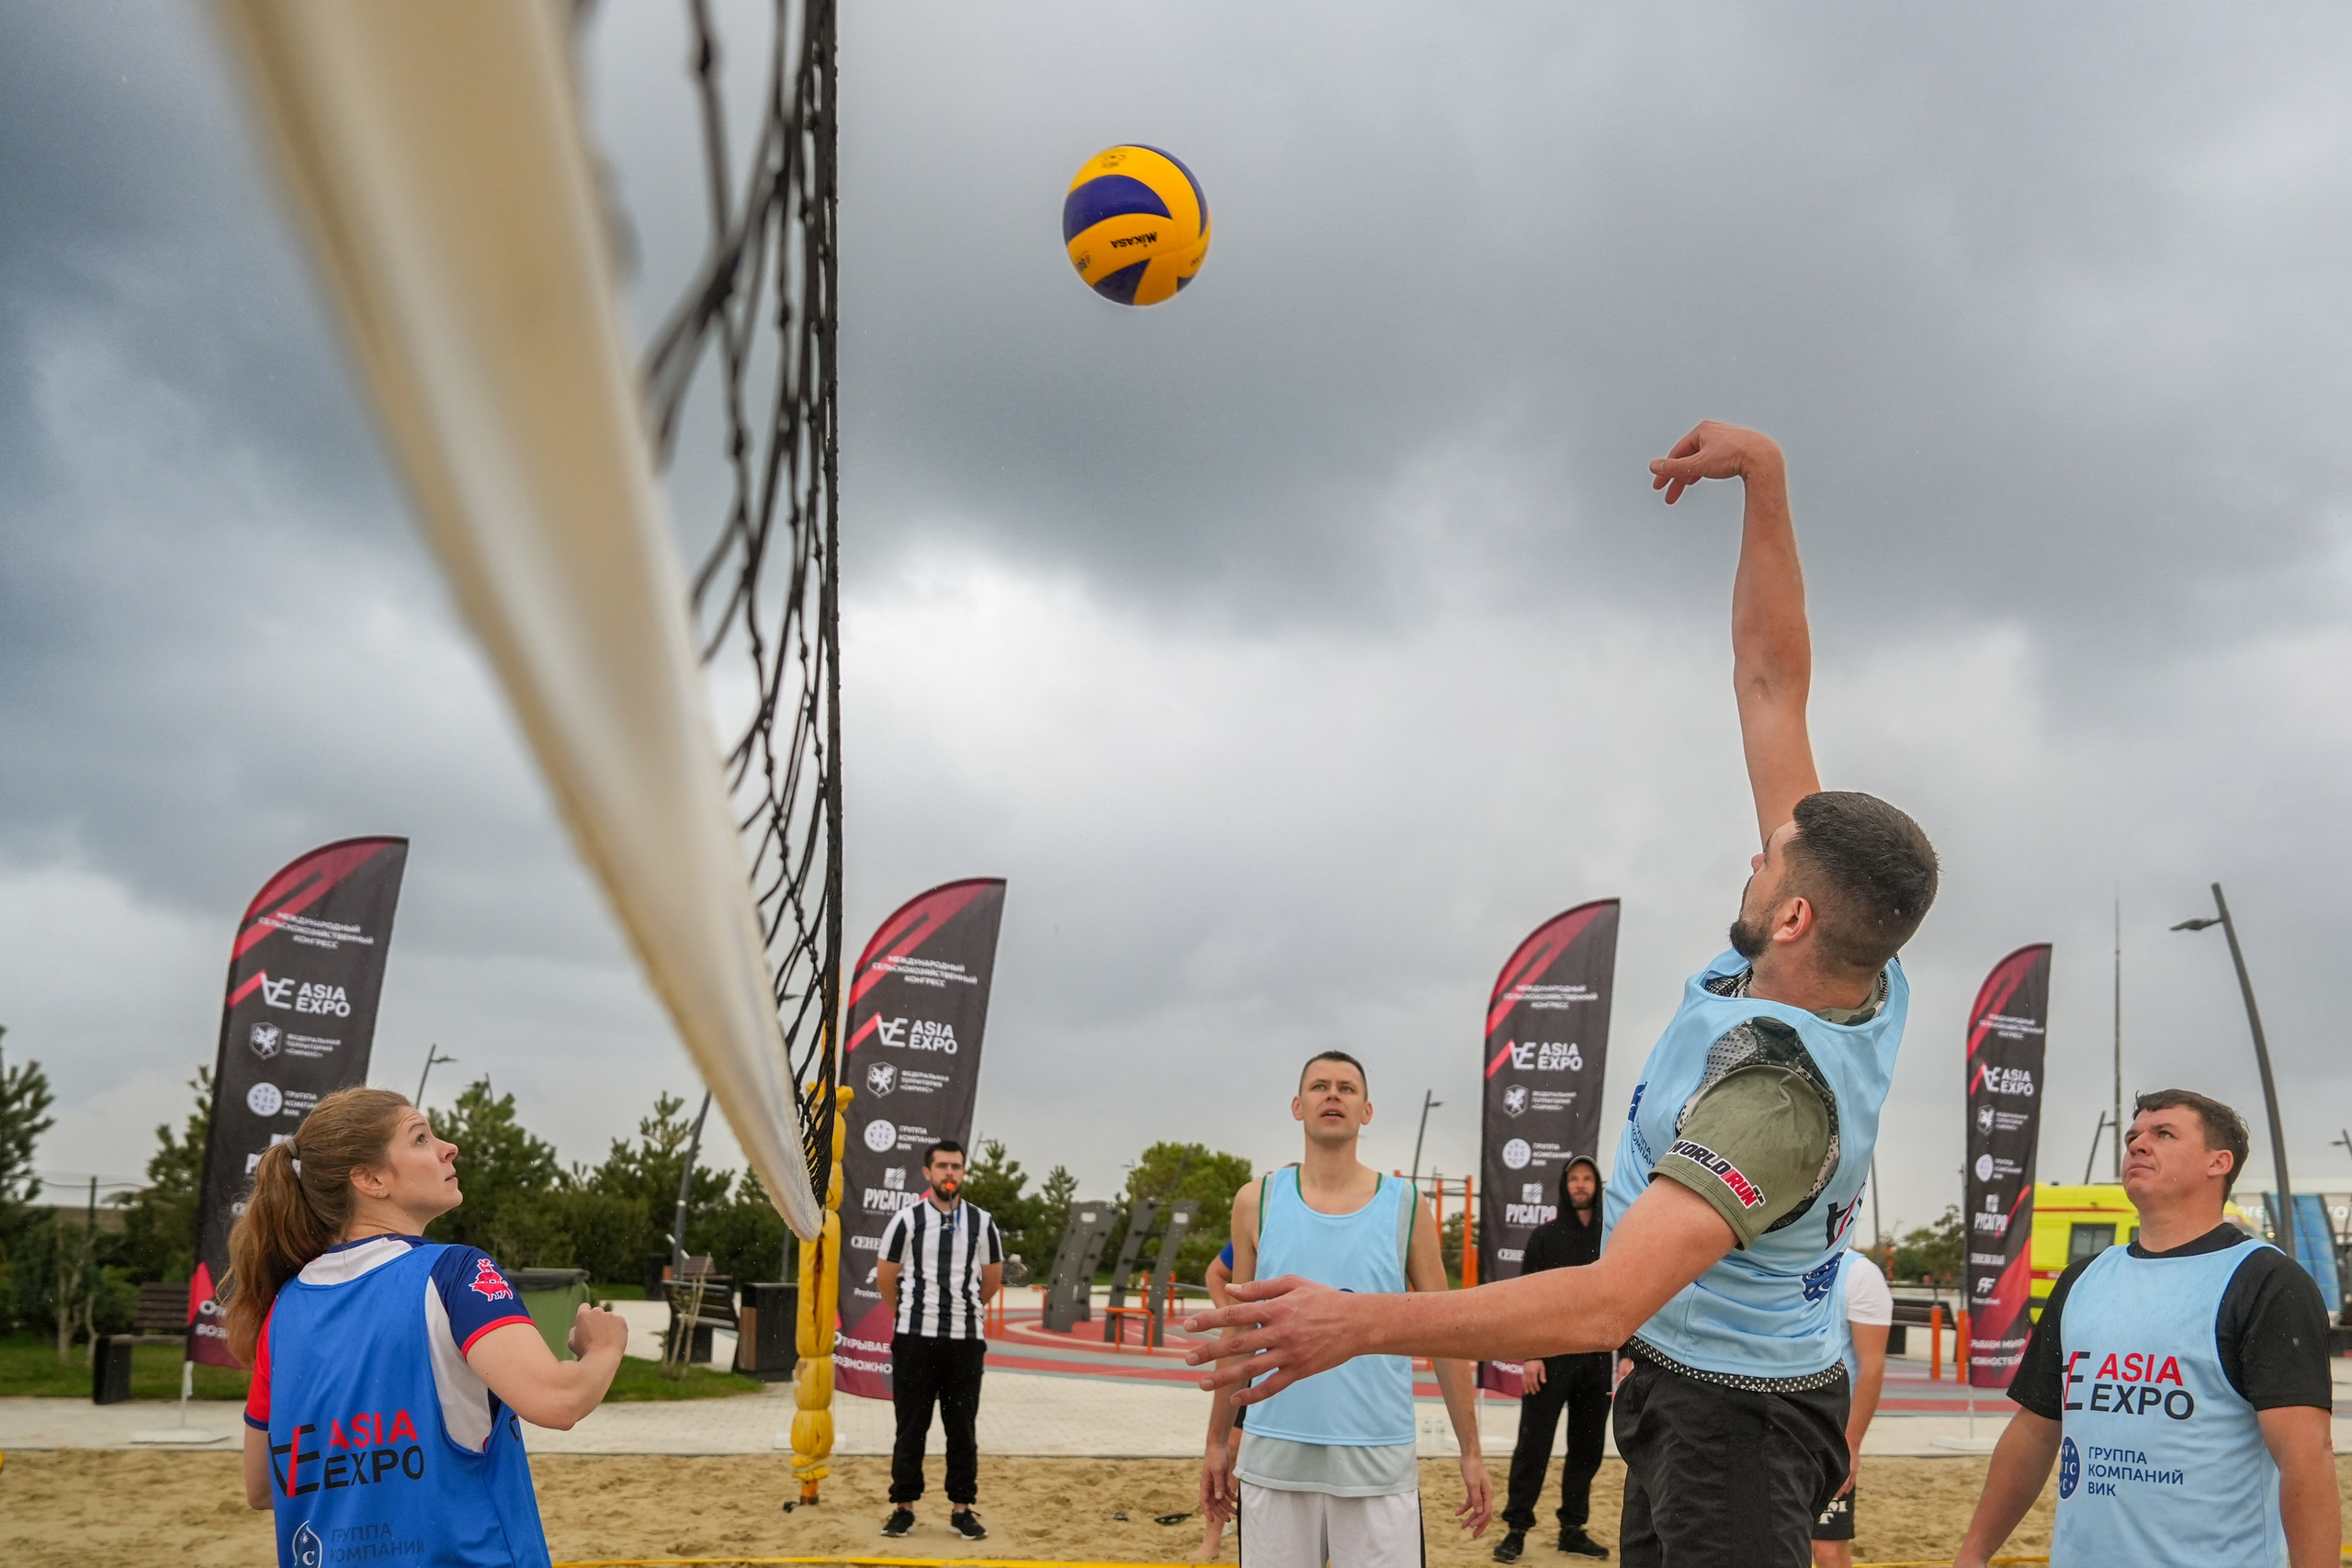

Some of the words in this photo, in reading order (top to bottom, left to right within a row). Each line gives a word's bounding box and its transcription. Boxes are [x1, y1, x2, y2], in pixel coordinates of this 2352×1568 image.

[298, 982, 347, 1002] ASIA
[295, 998, 351, 1018] EXPO
[910, 1019, 956, 1039] ASIA
[909, 1033, 958, 1055] EXPO
[1539, 1042, 1579, 1056] ASIA
[1537, 1055, 1583, 1071] EXPO
[2002, 1068, 2032, 1083] ASIA
[2000, 1080, 2034, 1097] EXPO
[1668, 1141, 1731, 1176] WORLD
[833, 1330, 892, 1353] ОТКРЫВАЕ
[2096, 1353, 2184, 1386] ASIA
[2090, 1383, 2195, 1420] EXPO
[328, 1409, 418, 1451] ASIA
[2088, 1447, 2147, 1464] ГРУППА
[323, 1445, 424, 1490] EXPO
[2087, 1463, 2184, 1485] КОМПАНИЙ
[2087, 1482, 2116, 1496] ВИК
[332, 1523, 392, 1543] ГРУППА
[330, 1537, 424, 1562] КОМПАНИЙ
